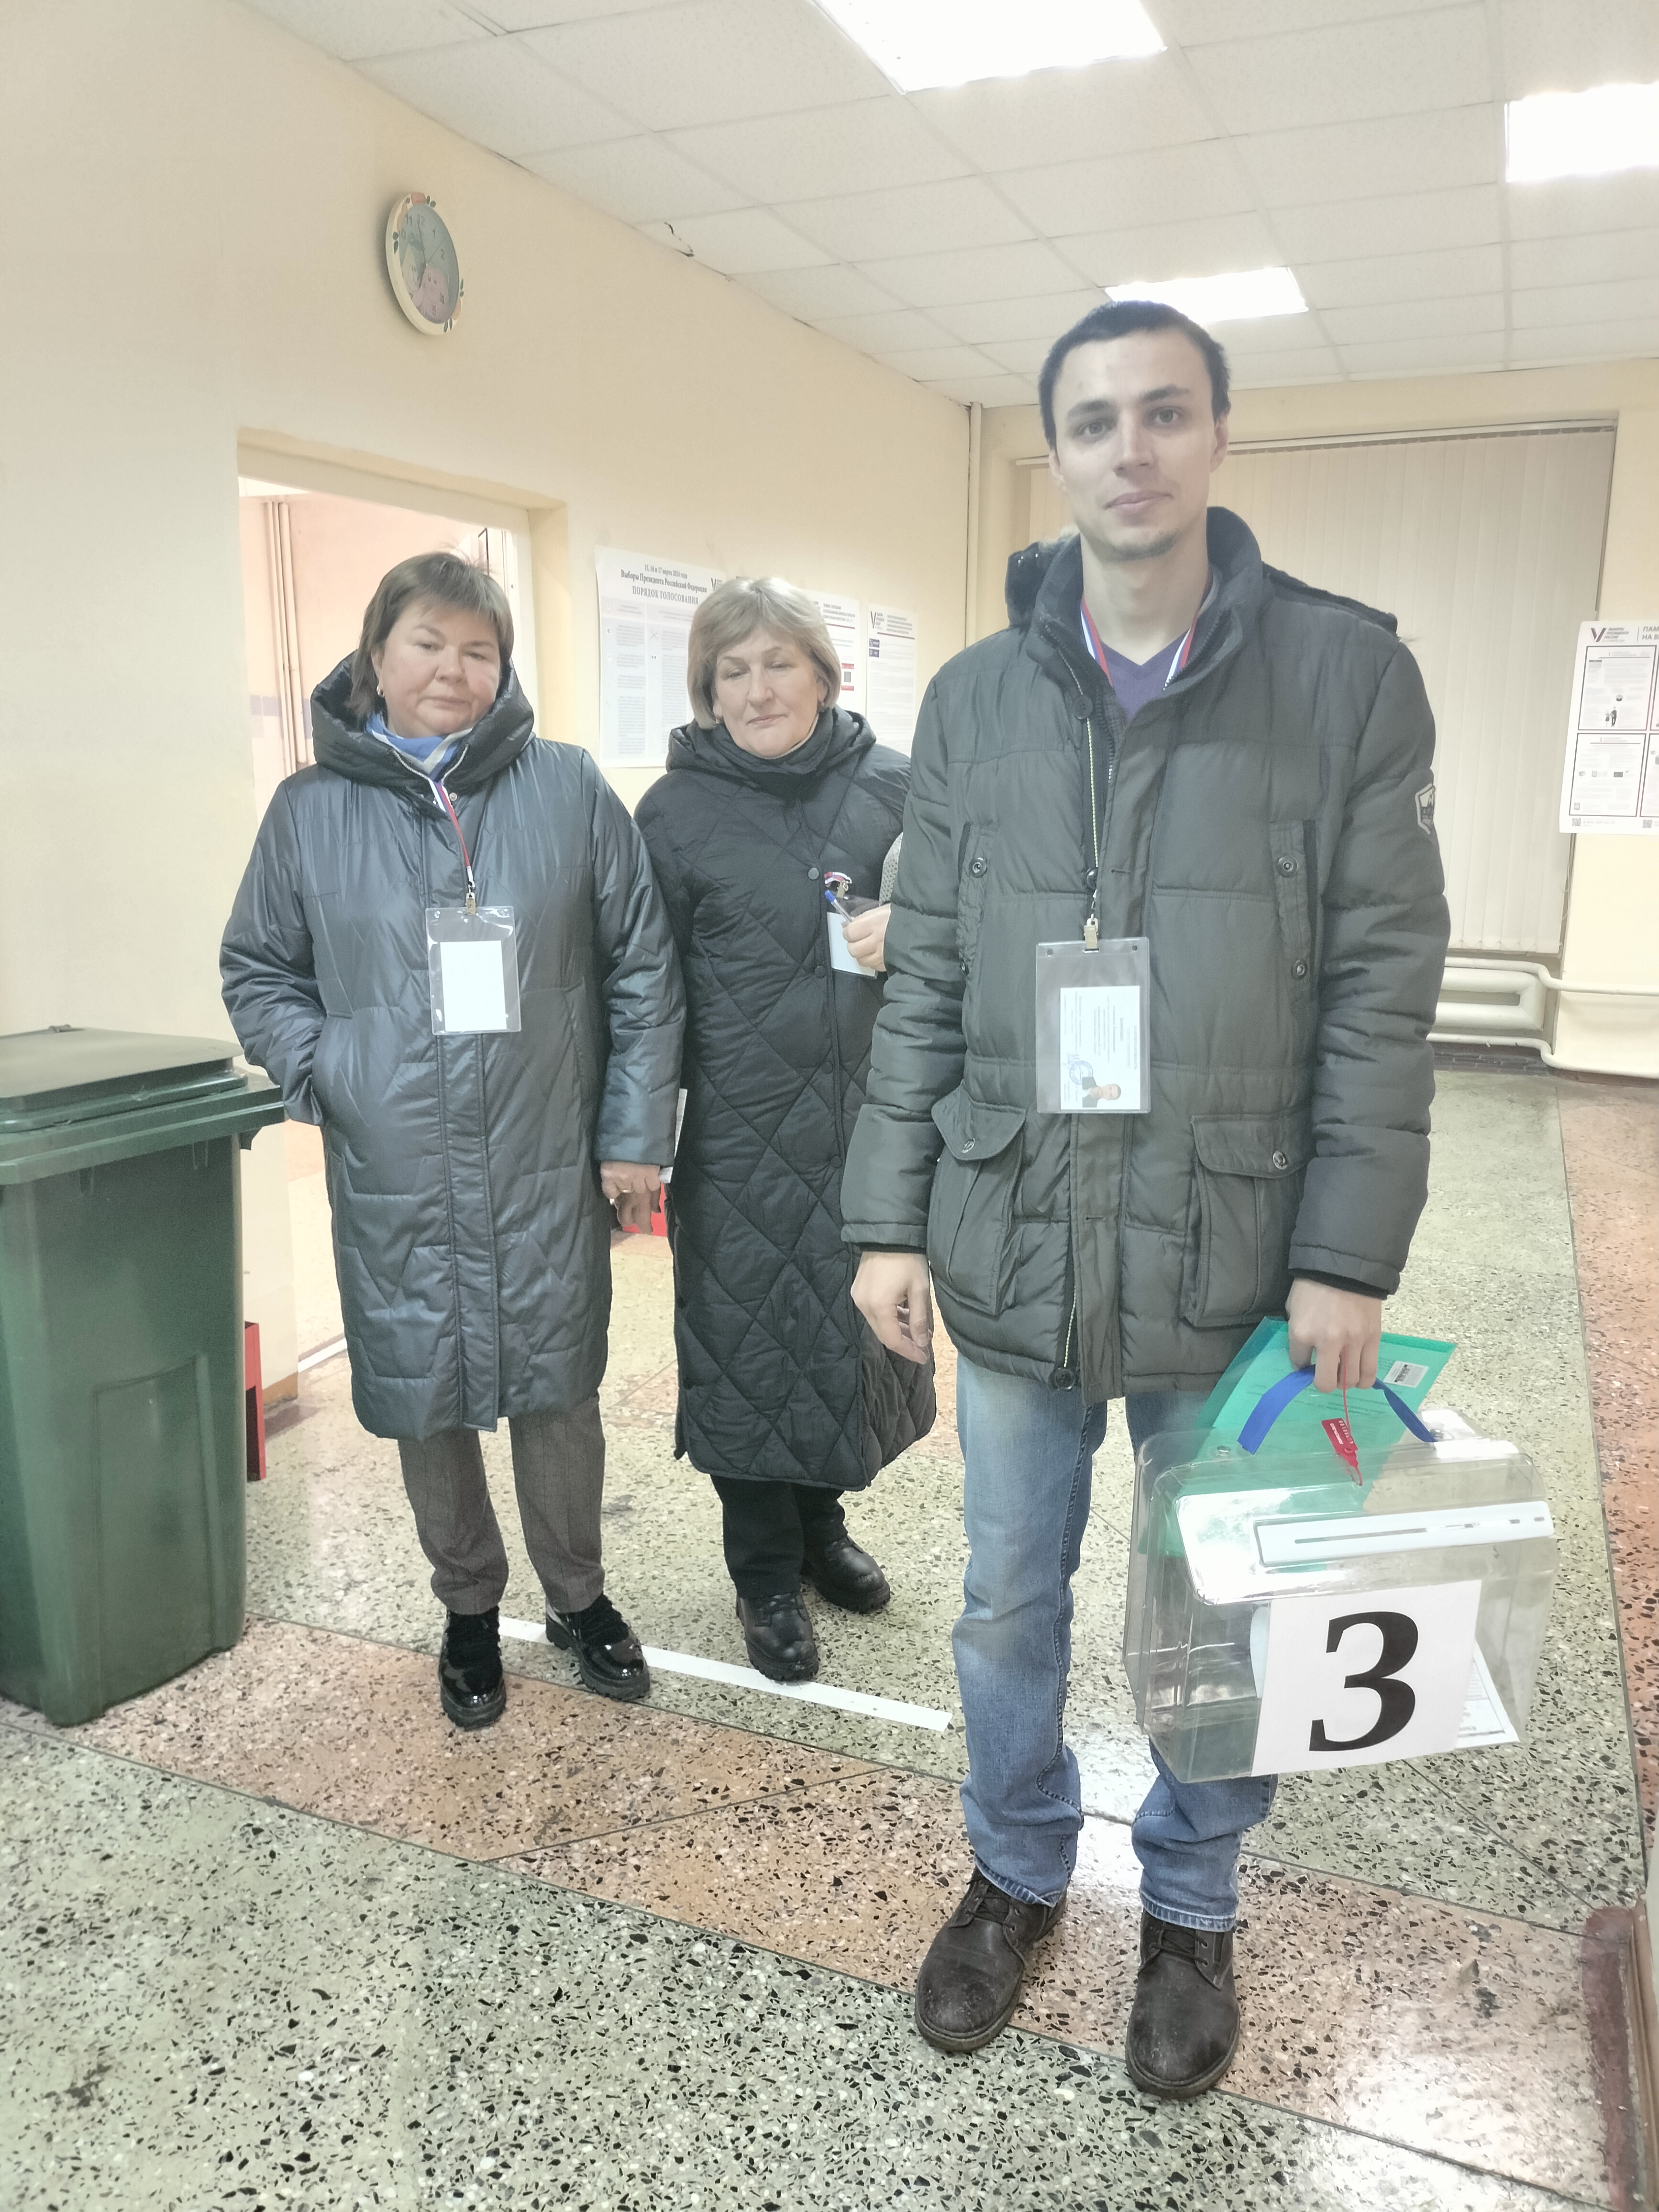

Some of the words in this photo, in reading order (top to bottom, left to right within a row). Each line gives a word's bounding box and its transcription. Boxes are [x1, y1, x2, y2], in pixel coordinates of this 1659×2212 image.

[405, 213, 412, 226] 11
[417, 213, 425, 227] 12
[432, 228, 436, 239] 1
[441, 248, 445, 260] 2
[621, 569, 639, 582] Выборы
[640, 573, 664, 585] Президента
[664, 578, 687, 589] Российской
[687, 582, 707, 593] Федерации
[632, 586, 659, 598] ПОРЯДОК
[660, 590, 698, 605] ГОЛОСОВАНИЯ
[1309, 1611, 1418, 1751] 3
